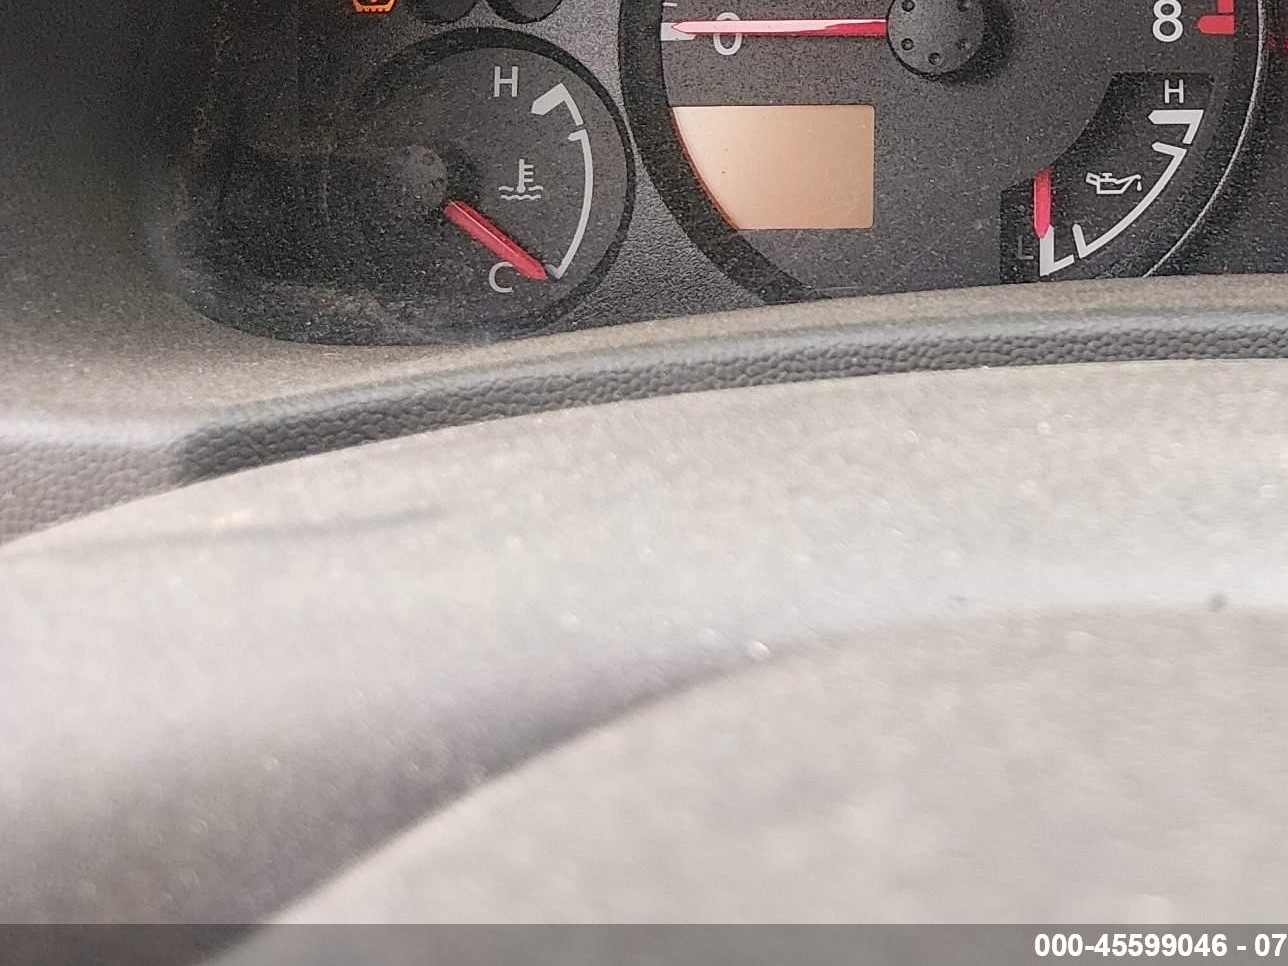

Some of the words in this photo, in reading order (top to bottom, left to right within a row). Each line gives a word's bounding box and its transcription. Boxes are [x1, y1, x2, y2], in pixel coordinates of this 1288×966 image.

[712, 13, 743, 56] 0
[494, 66, 519, 98] H
[1164, 79, 1184, 104] H
[489, 262, 513, 293] C
